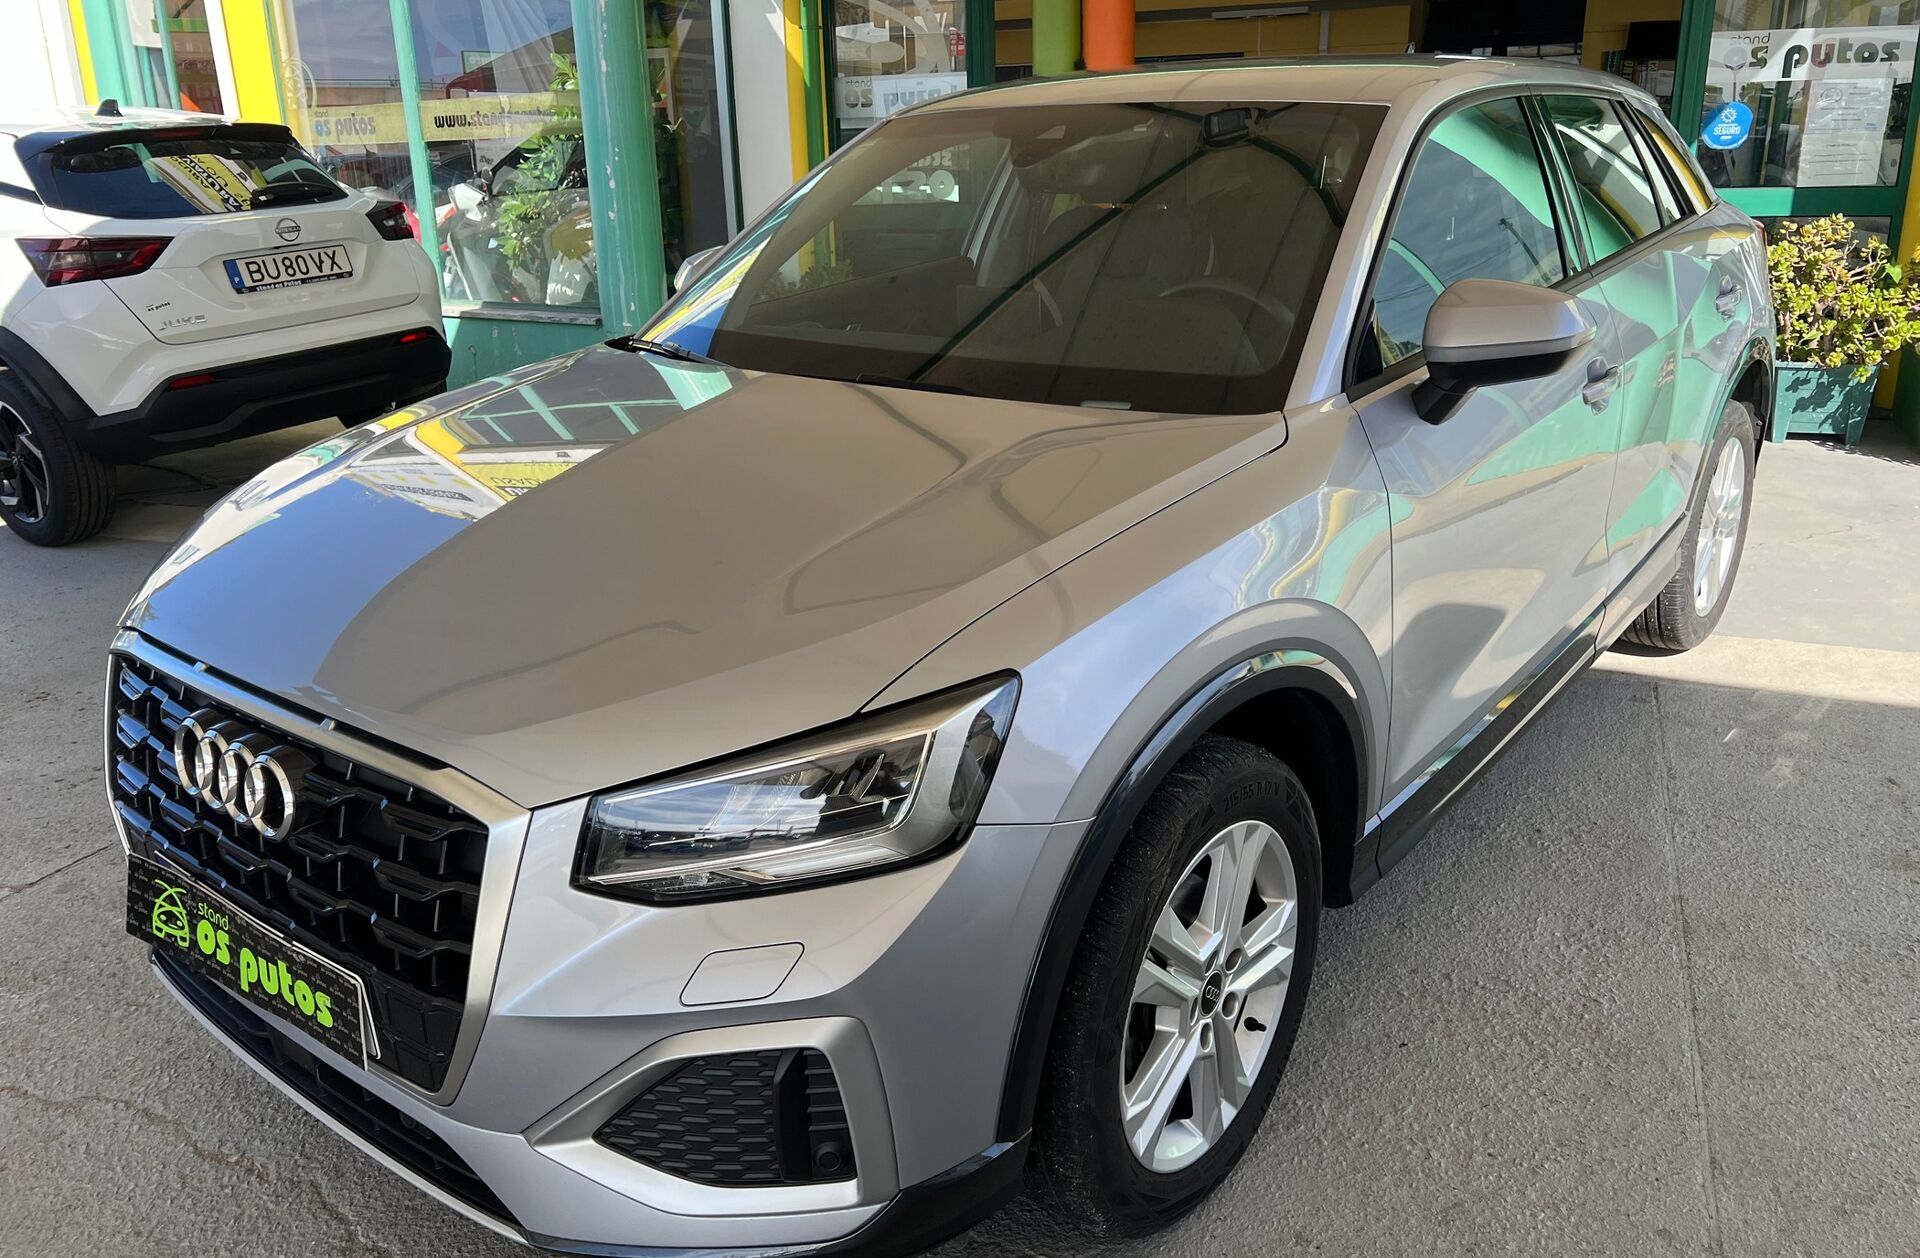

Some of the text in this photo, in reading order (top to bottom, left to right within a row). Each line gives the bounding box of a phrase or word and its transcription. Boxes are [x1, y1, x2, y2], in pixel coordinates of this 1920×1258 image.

[1729, 32, 1771, 46] stand
[1782, 38, 1901, 78] putos
[846, 77, 872, 88] stand
[315, 119, 331, 137] os
[335, 114, 376, 142] putos
[1713, 126, 1741, 136] SEGURO
[159, 314, 208, 332] JUKE
[197, 902, 229, 931] stand
[196, 919, 334, 1028] os putos
